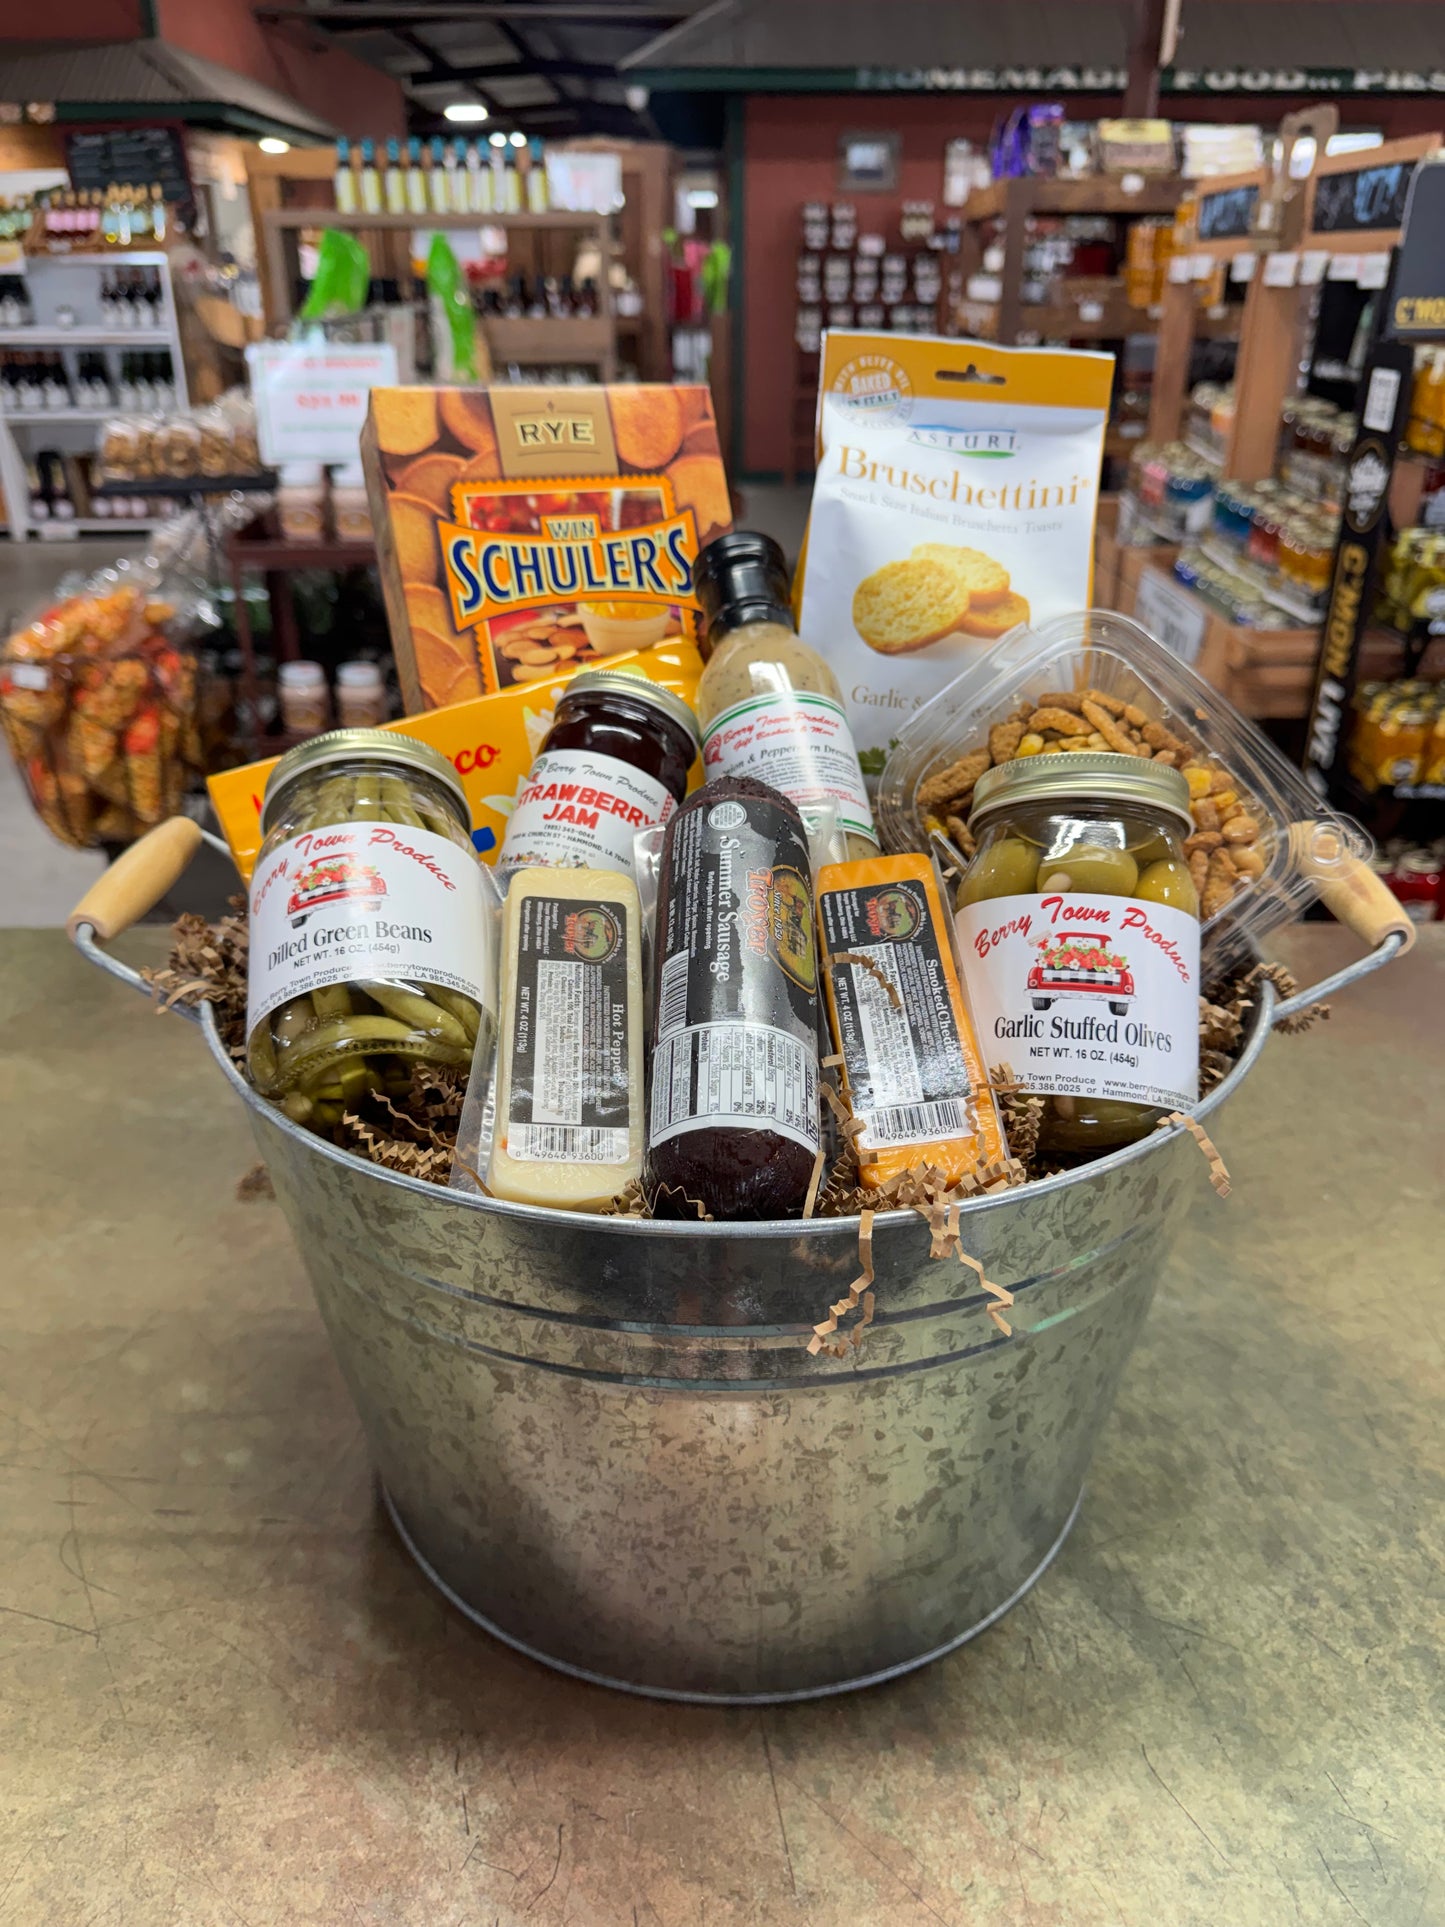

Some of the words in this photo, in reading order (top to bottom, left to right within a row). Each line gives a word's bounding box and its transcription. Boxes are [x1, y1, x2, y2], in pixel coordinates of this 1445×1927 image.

[850, 372, 891, 394] BAKED
[519, 421, 594, 444] RYE
[909, 431, 1017, 449] ASTURI
[549, 519, 597, 540] WIN
[451, 525, 697, 616] SCHULER'S
[851, 684, 910, 709] Garlic
[723, 724, 755, 744] Berry
[757, 715, 791, 727] Town
[794, 712, 840, 729] Produce
[747, 753, 755, 764] &
[547, 762, 577, 775] Berry
[582, 764, 613, 782] Town
[616, 775, 659, 808] Produce
[542, 803, 600, 830] JAM
[567, 836, 603, 853] HAMMOND,
[604, 848, 613, 857] LA
[253, 858, 290, 917] Berry
[294, 833, 357, 856] Town
[369, 828, 457, 892] Produce
[718, 838, 741, 908] Summer
[706, 870, 715, 906] Refrigerate
[742, 869, 774, 957] Troyer
[773, 890, 782, 915] Since
[703, 923, 713, 950] opening
[773, 916, 783, 941] 1959
[267, 934, 308, 971] Dilled
[313, 924, 370, 948] Green
[375, 921, 433, 944] Beans
[522, 934, 530, 951] opening
[709, 911, 739, 983] Sausage
[974, 914, 1033, 958] Berry
[1040, 895, 1112, 923] Town
[1119, 906, 1191, 984] Produce
[293, 953, 311, 969] NET
[313, 948, 333, 962] WT.
[334, 946, 346, 955] 16
[368, 943, 400, 954] (454g)
[885, 944, 897, 970] Nutrition
[290, 976, 311, 988] Town
[414, 971, 427, 979] LA
[574, 964, 582, 988] Nutrition
[838, 977, 848, 991] NET
[521, 986, 530, 1000] NET
[574, 990, 582, 1008] Facts:
[840, 991, 851, 1005] WT.
[520, 1001, 530, 1014] WT.
[612, 1003, 625, 1027] Hot
[845, 1010, 854, 1022] OZ
[520, 1020, 529, 1031] OZ
[844, 1022, 856, 1044] (113g)
[994, 1014, 1045, 1039] Garlic
[1050, 1016, 1118, 1044] Stuffed
[1125, 1022, 1172, 1053] Olives
[517, 1032, 528, 1053] (113g)
[701, 1030, 710, 1052] Protein
[767, 1032, 776, 1067] Cholesterol
[610, 1030, 625, 1077] Pepper
[721, 1045, 731, 1063] Sugars
[734, 1050, 743, 1063] Fiber
[777, 1053, 785, 1063] Fat
[1029, 1046, 1050, 1058] NET
[1052, 1047, 1073, 1059] WT.
[1076, 1048, 1087, 1060] 16
[1090, 1051, 1107, 1062] OZ.
[1109, 1053, 1139, 1068] (454g)
[711, 1063, 720, 1079] Added
[720, 1063, 731, 1071] 2g
[743, 1046, 754, 1087] Carbohydrate
[709, 1079, 719, 1097] Sugars
[1028, 1073, 1052, 1081] Town
[1055, 1074, 1096, 1084] Produce
[743, 1088, 752, 1096] 1g
[1152, 1094, 1162, 1103] LA
[733, 1101, 743, 1112] 0%
[745, 1102, 754, 1114] 0%
[756, 1099, 766, 1115] 32%
[885, 1130, 918, 1141] 49646
[921, 1125, 954, 1136] 93602
[534, 1150, 567, 1160] 49646
[571, 1151, 604, 1161] 93600
